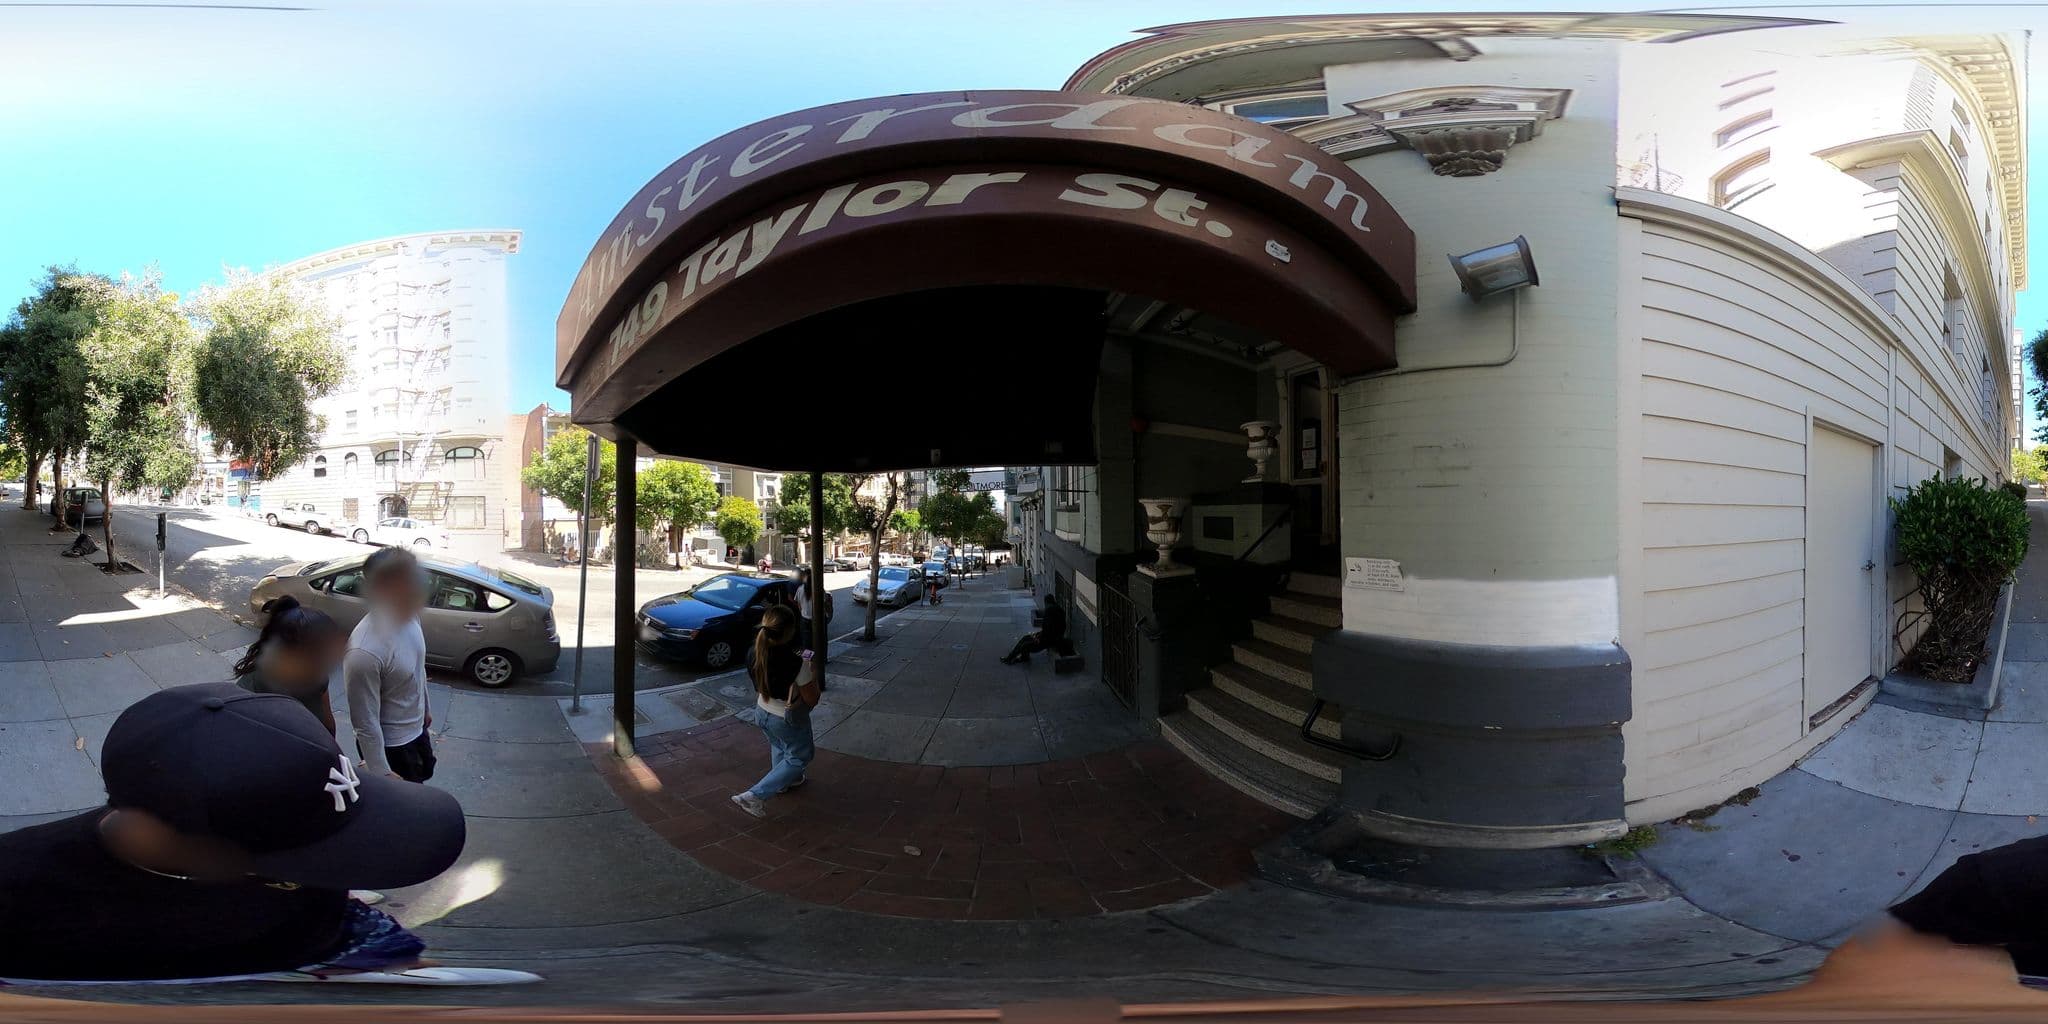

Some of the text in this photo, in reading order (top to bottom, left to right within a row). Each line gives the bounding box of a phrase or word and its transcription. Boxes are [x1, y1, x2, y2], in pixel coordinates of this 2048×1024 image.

[569, 100, 1371, 354] Amsterdam
[609, 172, 1233, 365] 749 Taylor St.
[324, 754, 361, 812] NY
